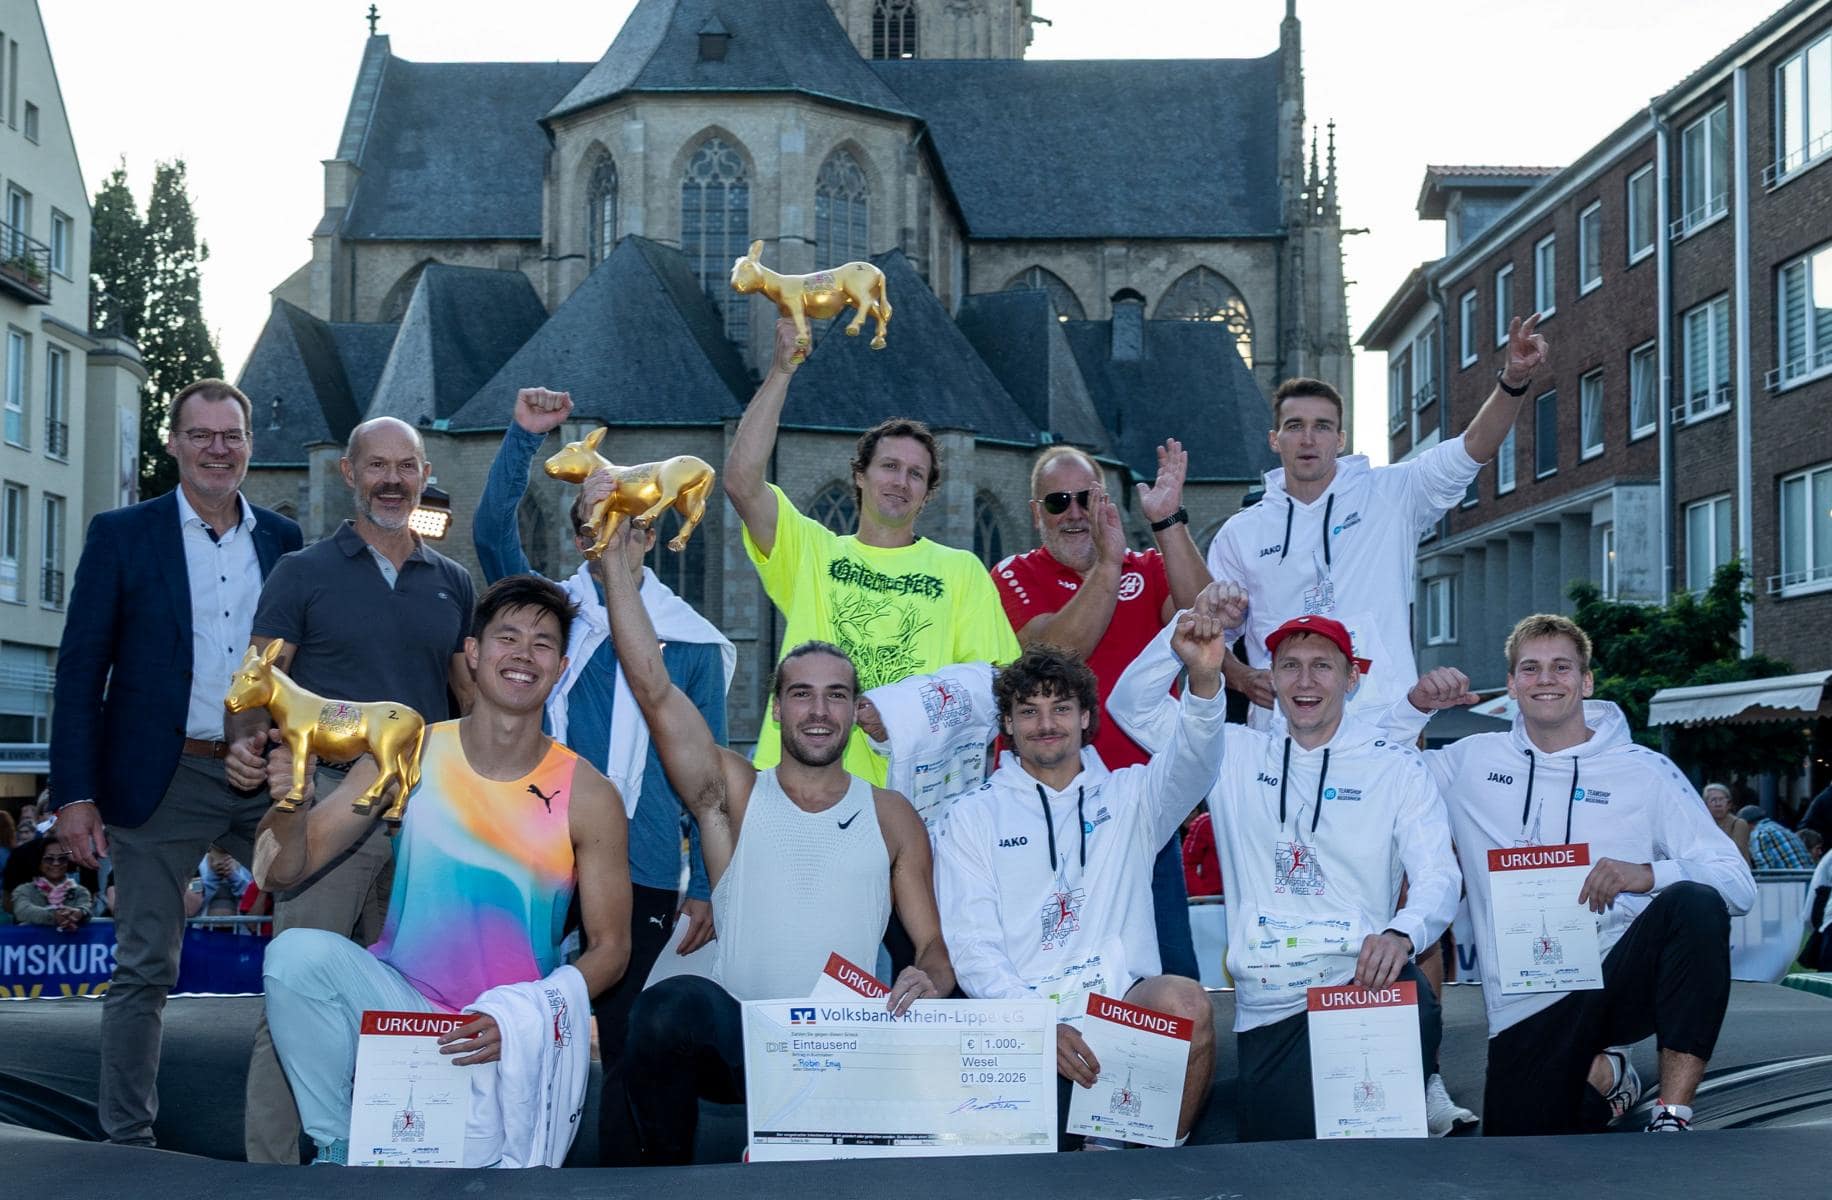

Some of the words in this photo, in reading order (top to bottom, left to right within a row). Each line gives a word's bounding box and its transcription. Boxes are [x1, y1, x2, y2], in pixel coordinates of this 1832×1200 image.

[1260, 545, 1282, 557] JAKO
[1487, 772, 1513, 785] JAKO
[998, 836, 1028, 848] JAKO
[1501, 850, 1576, 868] URKUNDE
[0, 944, 119, 976] MSKUR
[1321, 989, 1402, 1007] URKUNDE
[821, 1008, 897, 1023] Volksbank
[1100, 1002, 1178, 1035] URKUNDE
[793, 1040, 857, 1050] Eintausend
[967, 1039, 975, 1049] €
[962, 1056, 999, 1067] Wesel
[961, 1072, 1027, 1083] 01.09.2026
